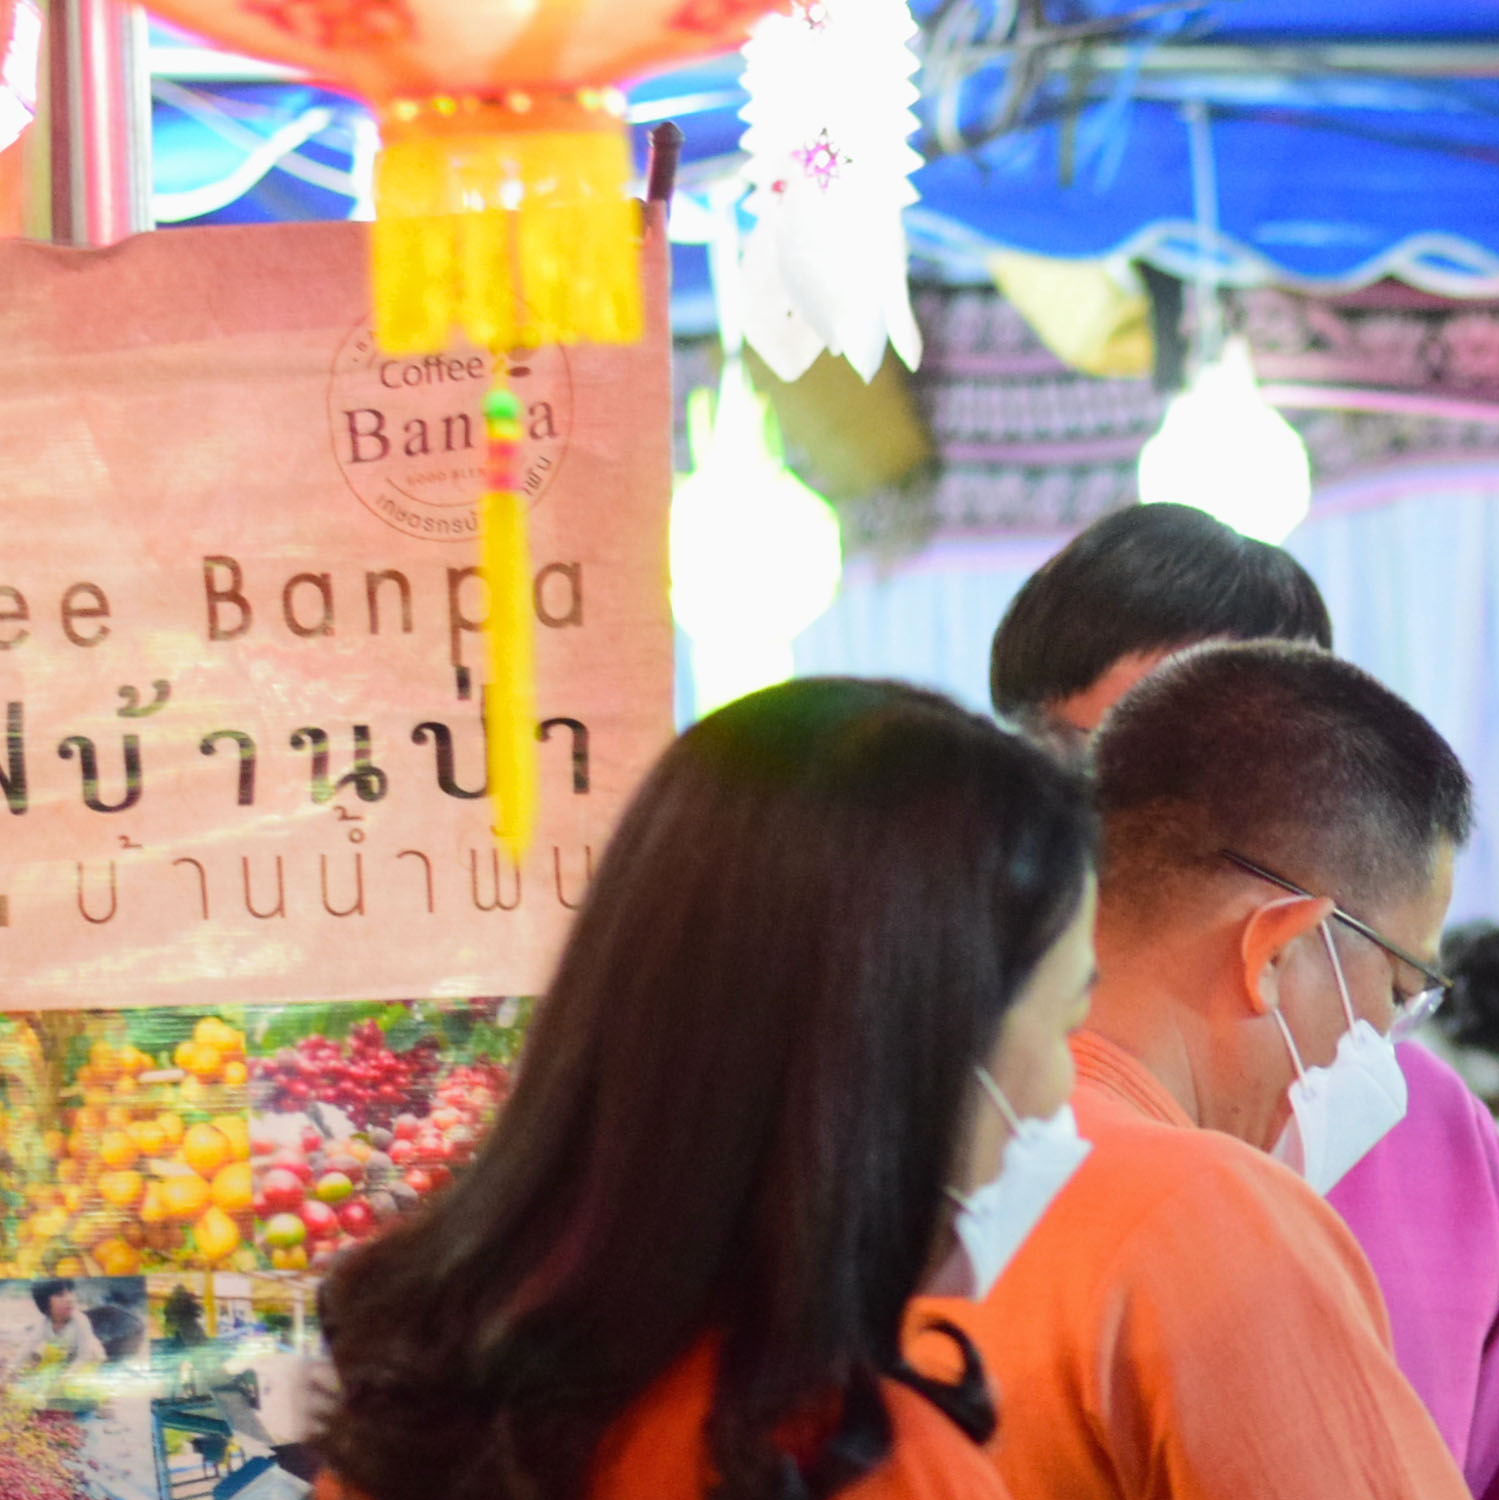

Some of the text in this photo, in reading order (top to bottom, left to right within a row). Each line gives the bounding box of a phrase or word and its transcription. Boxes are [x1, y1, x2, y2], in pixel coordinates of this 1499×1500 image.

[379, 354, 484, 389] Coffee
[343, 400, 559, 464] Bana
[202, 554, 583, 667] Banpa
